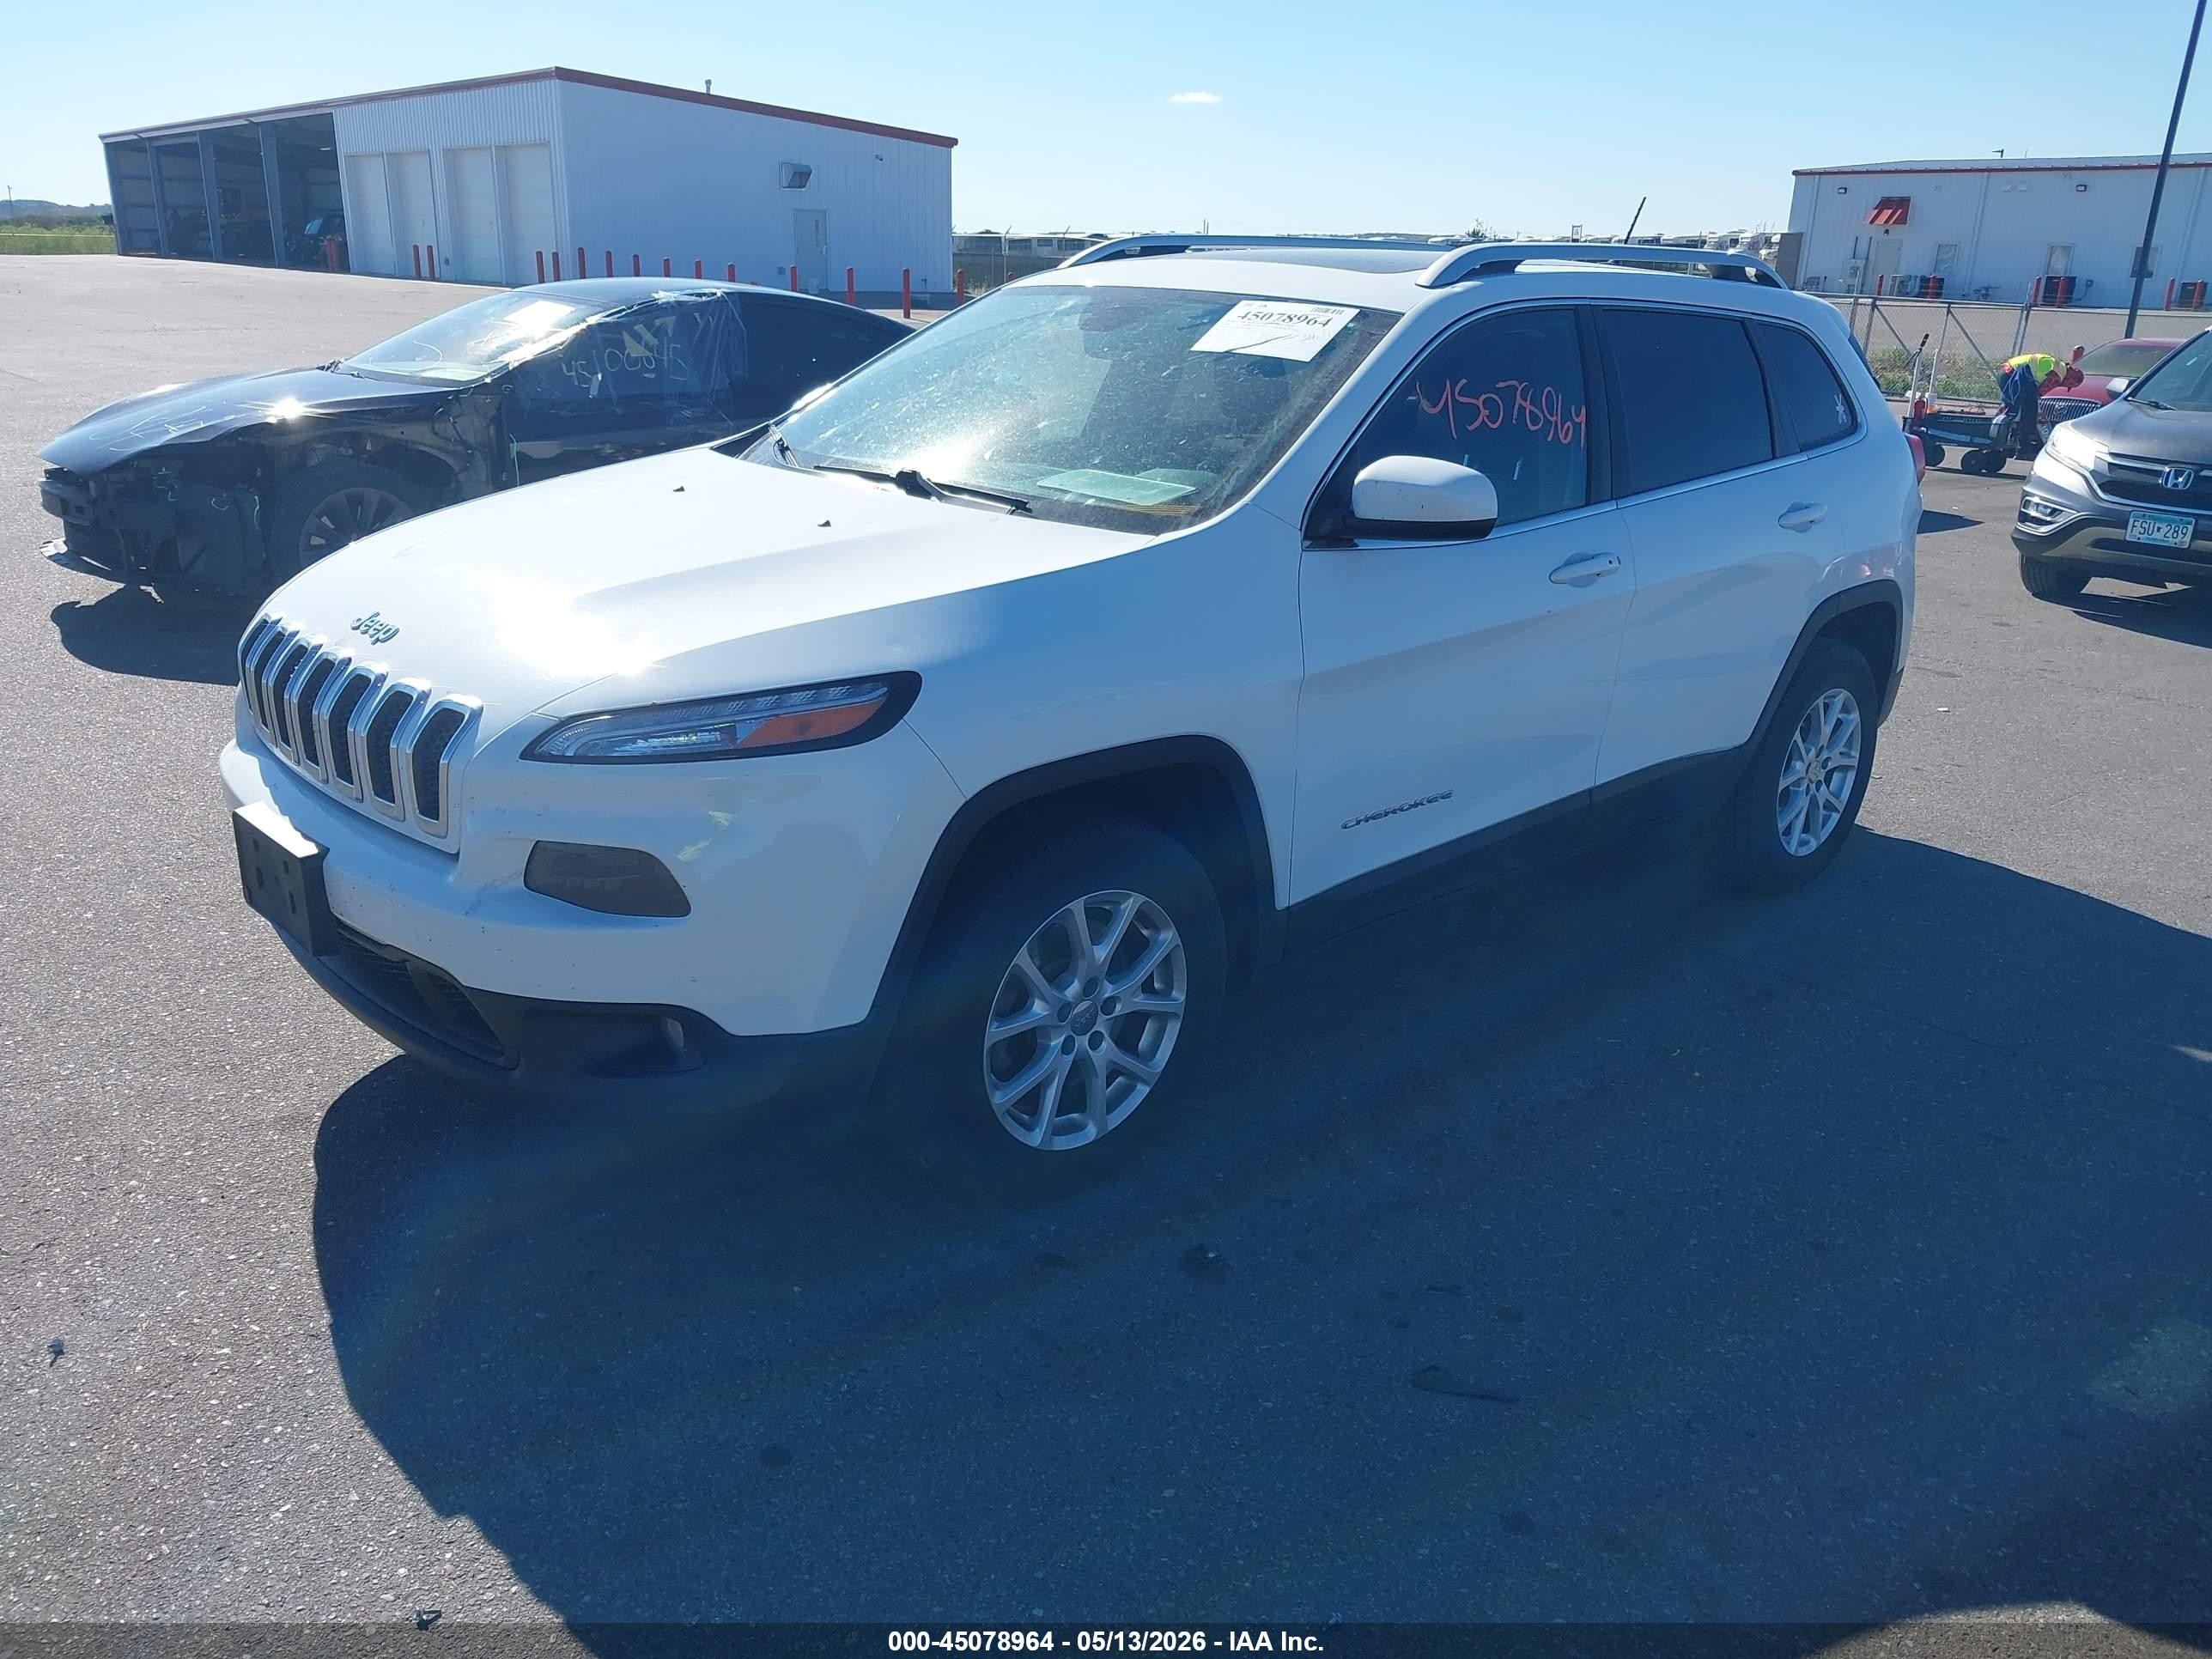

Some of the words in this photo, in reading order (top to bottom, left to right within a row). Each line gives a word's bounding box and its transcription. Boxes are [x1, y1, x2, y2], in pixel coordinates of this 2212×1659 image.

[1237, 310, 1334, 327] 45078964
[1416, 378, 1586, 450] 45078964
[2130, 520, 2157, 537] FSU
[2163, 523, 2190, 540] 289
[350, 611, 400, 646] Jeep
